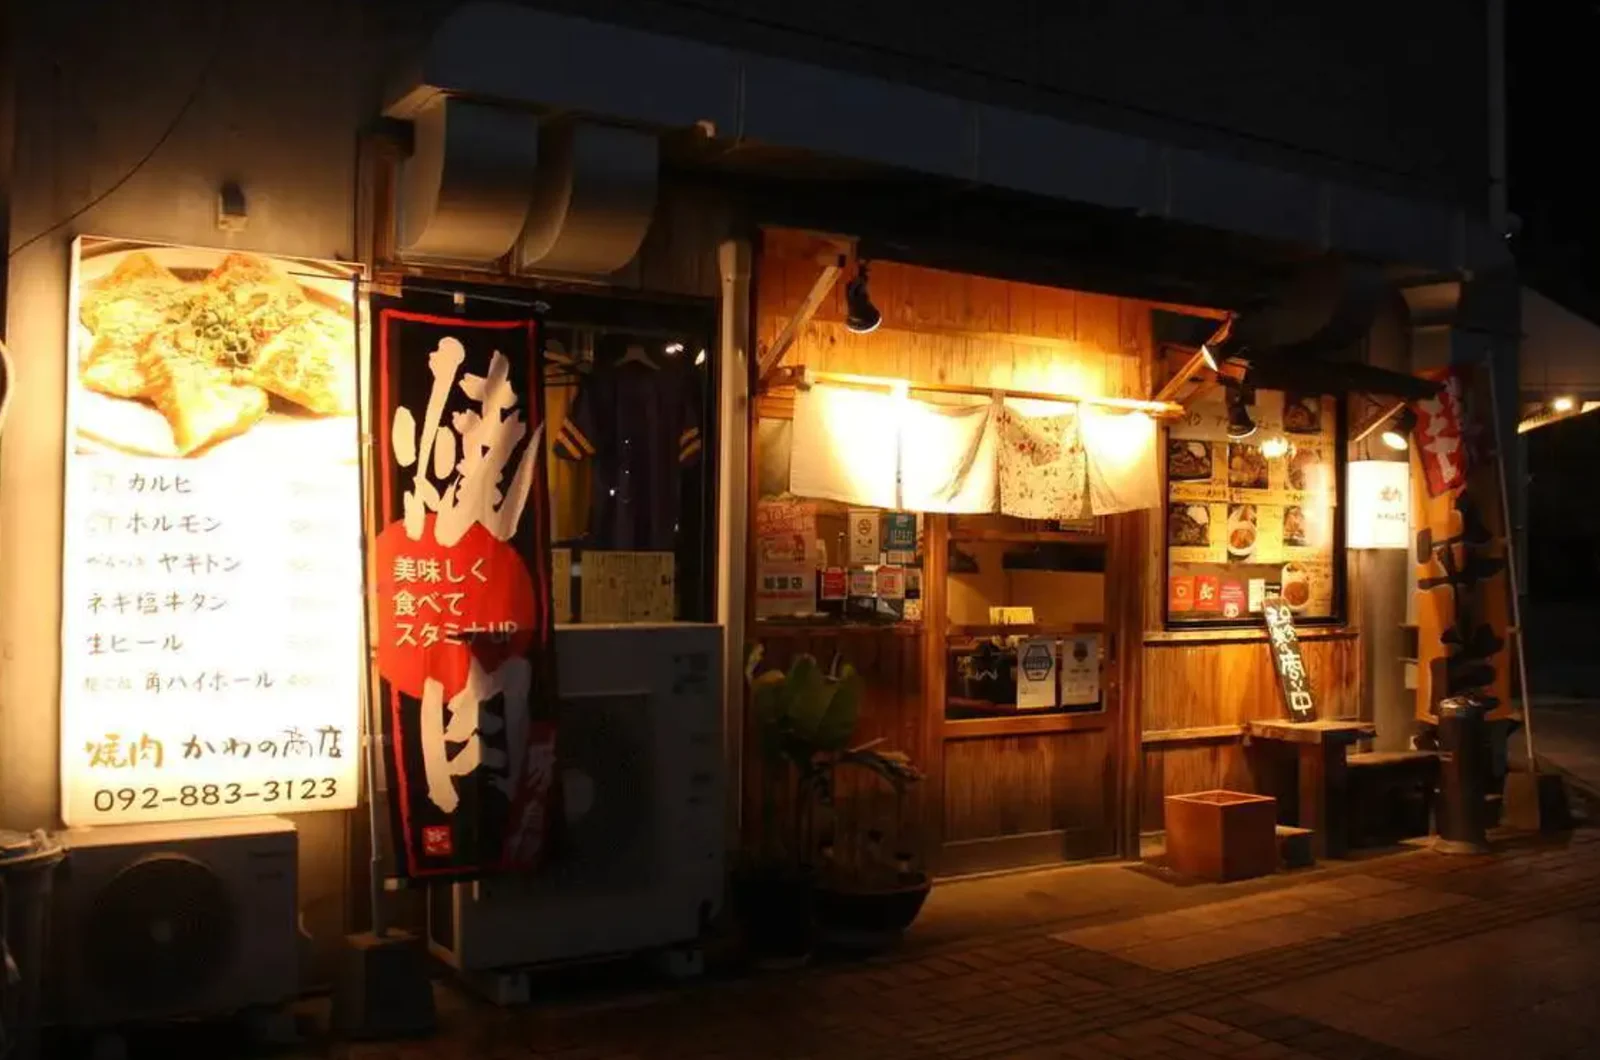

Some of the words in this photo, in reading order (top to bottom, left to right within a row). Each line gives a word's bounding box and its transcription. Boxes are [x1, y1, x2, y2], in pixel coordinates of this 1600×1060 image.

[126, 509, 224, 536] ホルモン
[156, 552, 244, 576] ヤキトン
[393, 556, 489, 584] 美味しく
[392, 588, 467, 618] 食べて
[394, 619, 520, 649] スタミナUP
[83, 731, 165, 770] 焼肉
[181, 723, 345, 762] かわの商店
[93, 776, 339, 813] 092-883-3123
